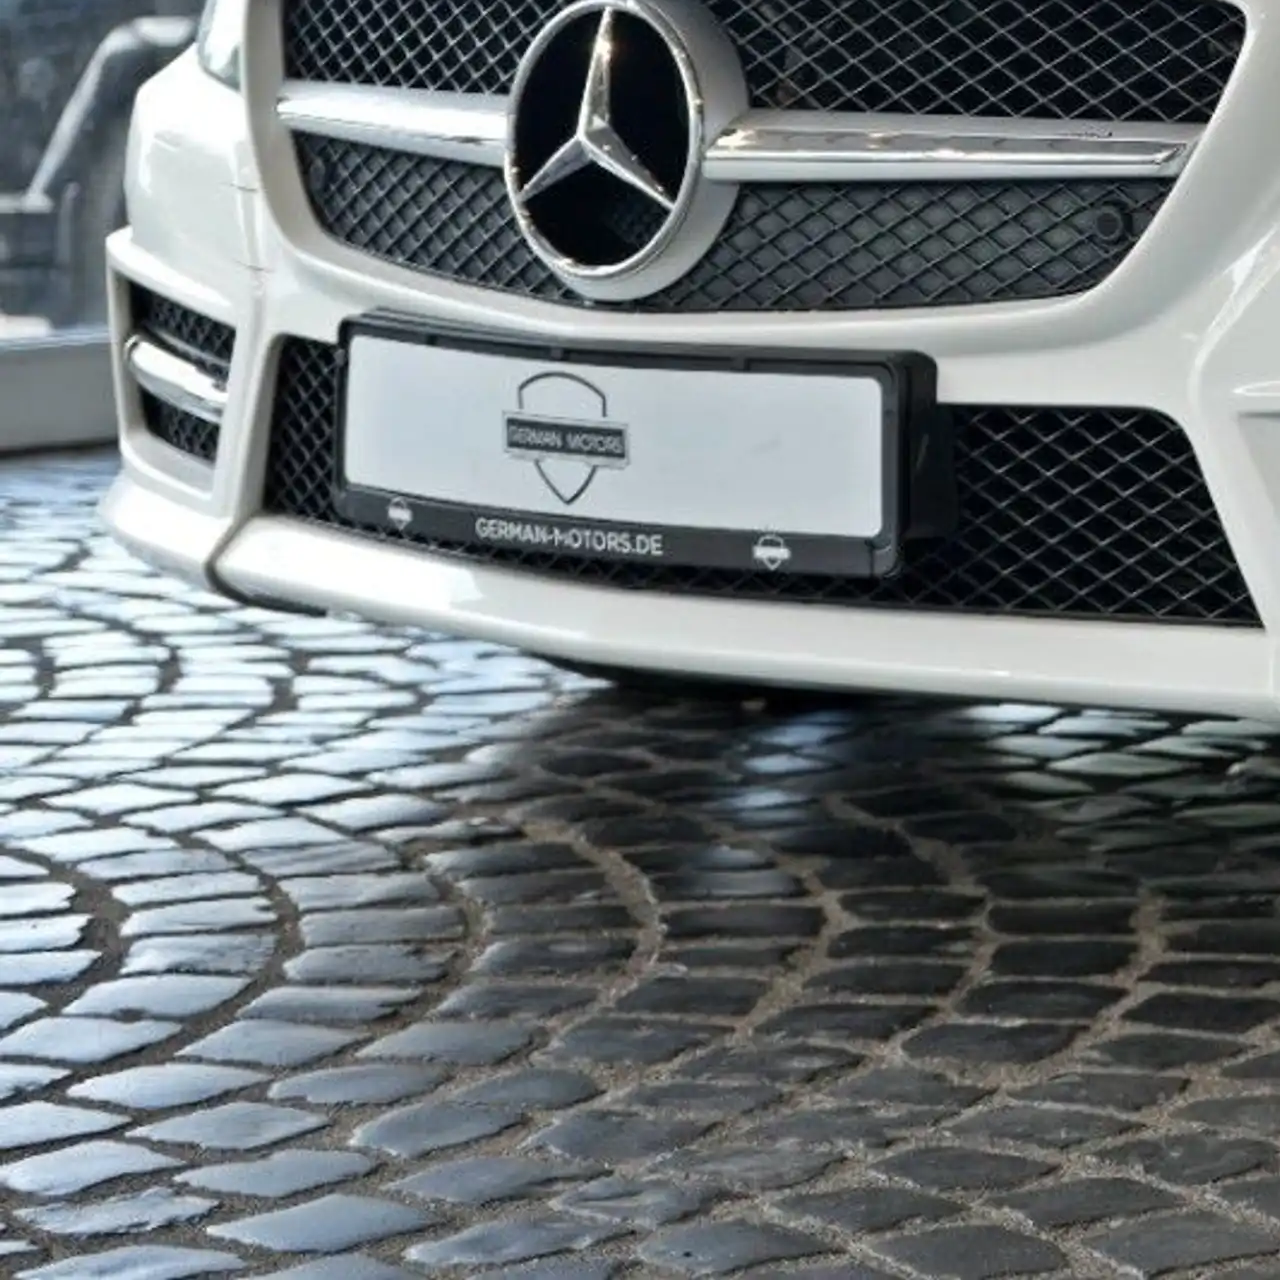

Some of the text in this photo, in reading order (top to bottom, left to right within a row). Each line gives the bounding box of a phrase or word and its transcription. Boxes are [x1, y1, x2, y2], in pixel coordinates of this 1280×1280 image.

[511, 426, 622, 454] GERMAN MOTORS
[475, 517, 663, 555] GERMAN-MOTORS.DE
